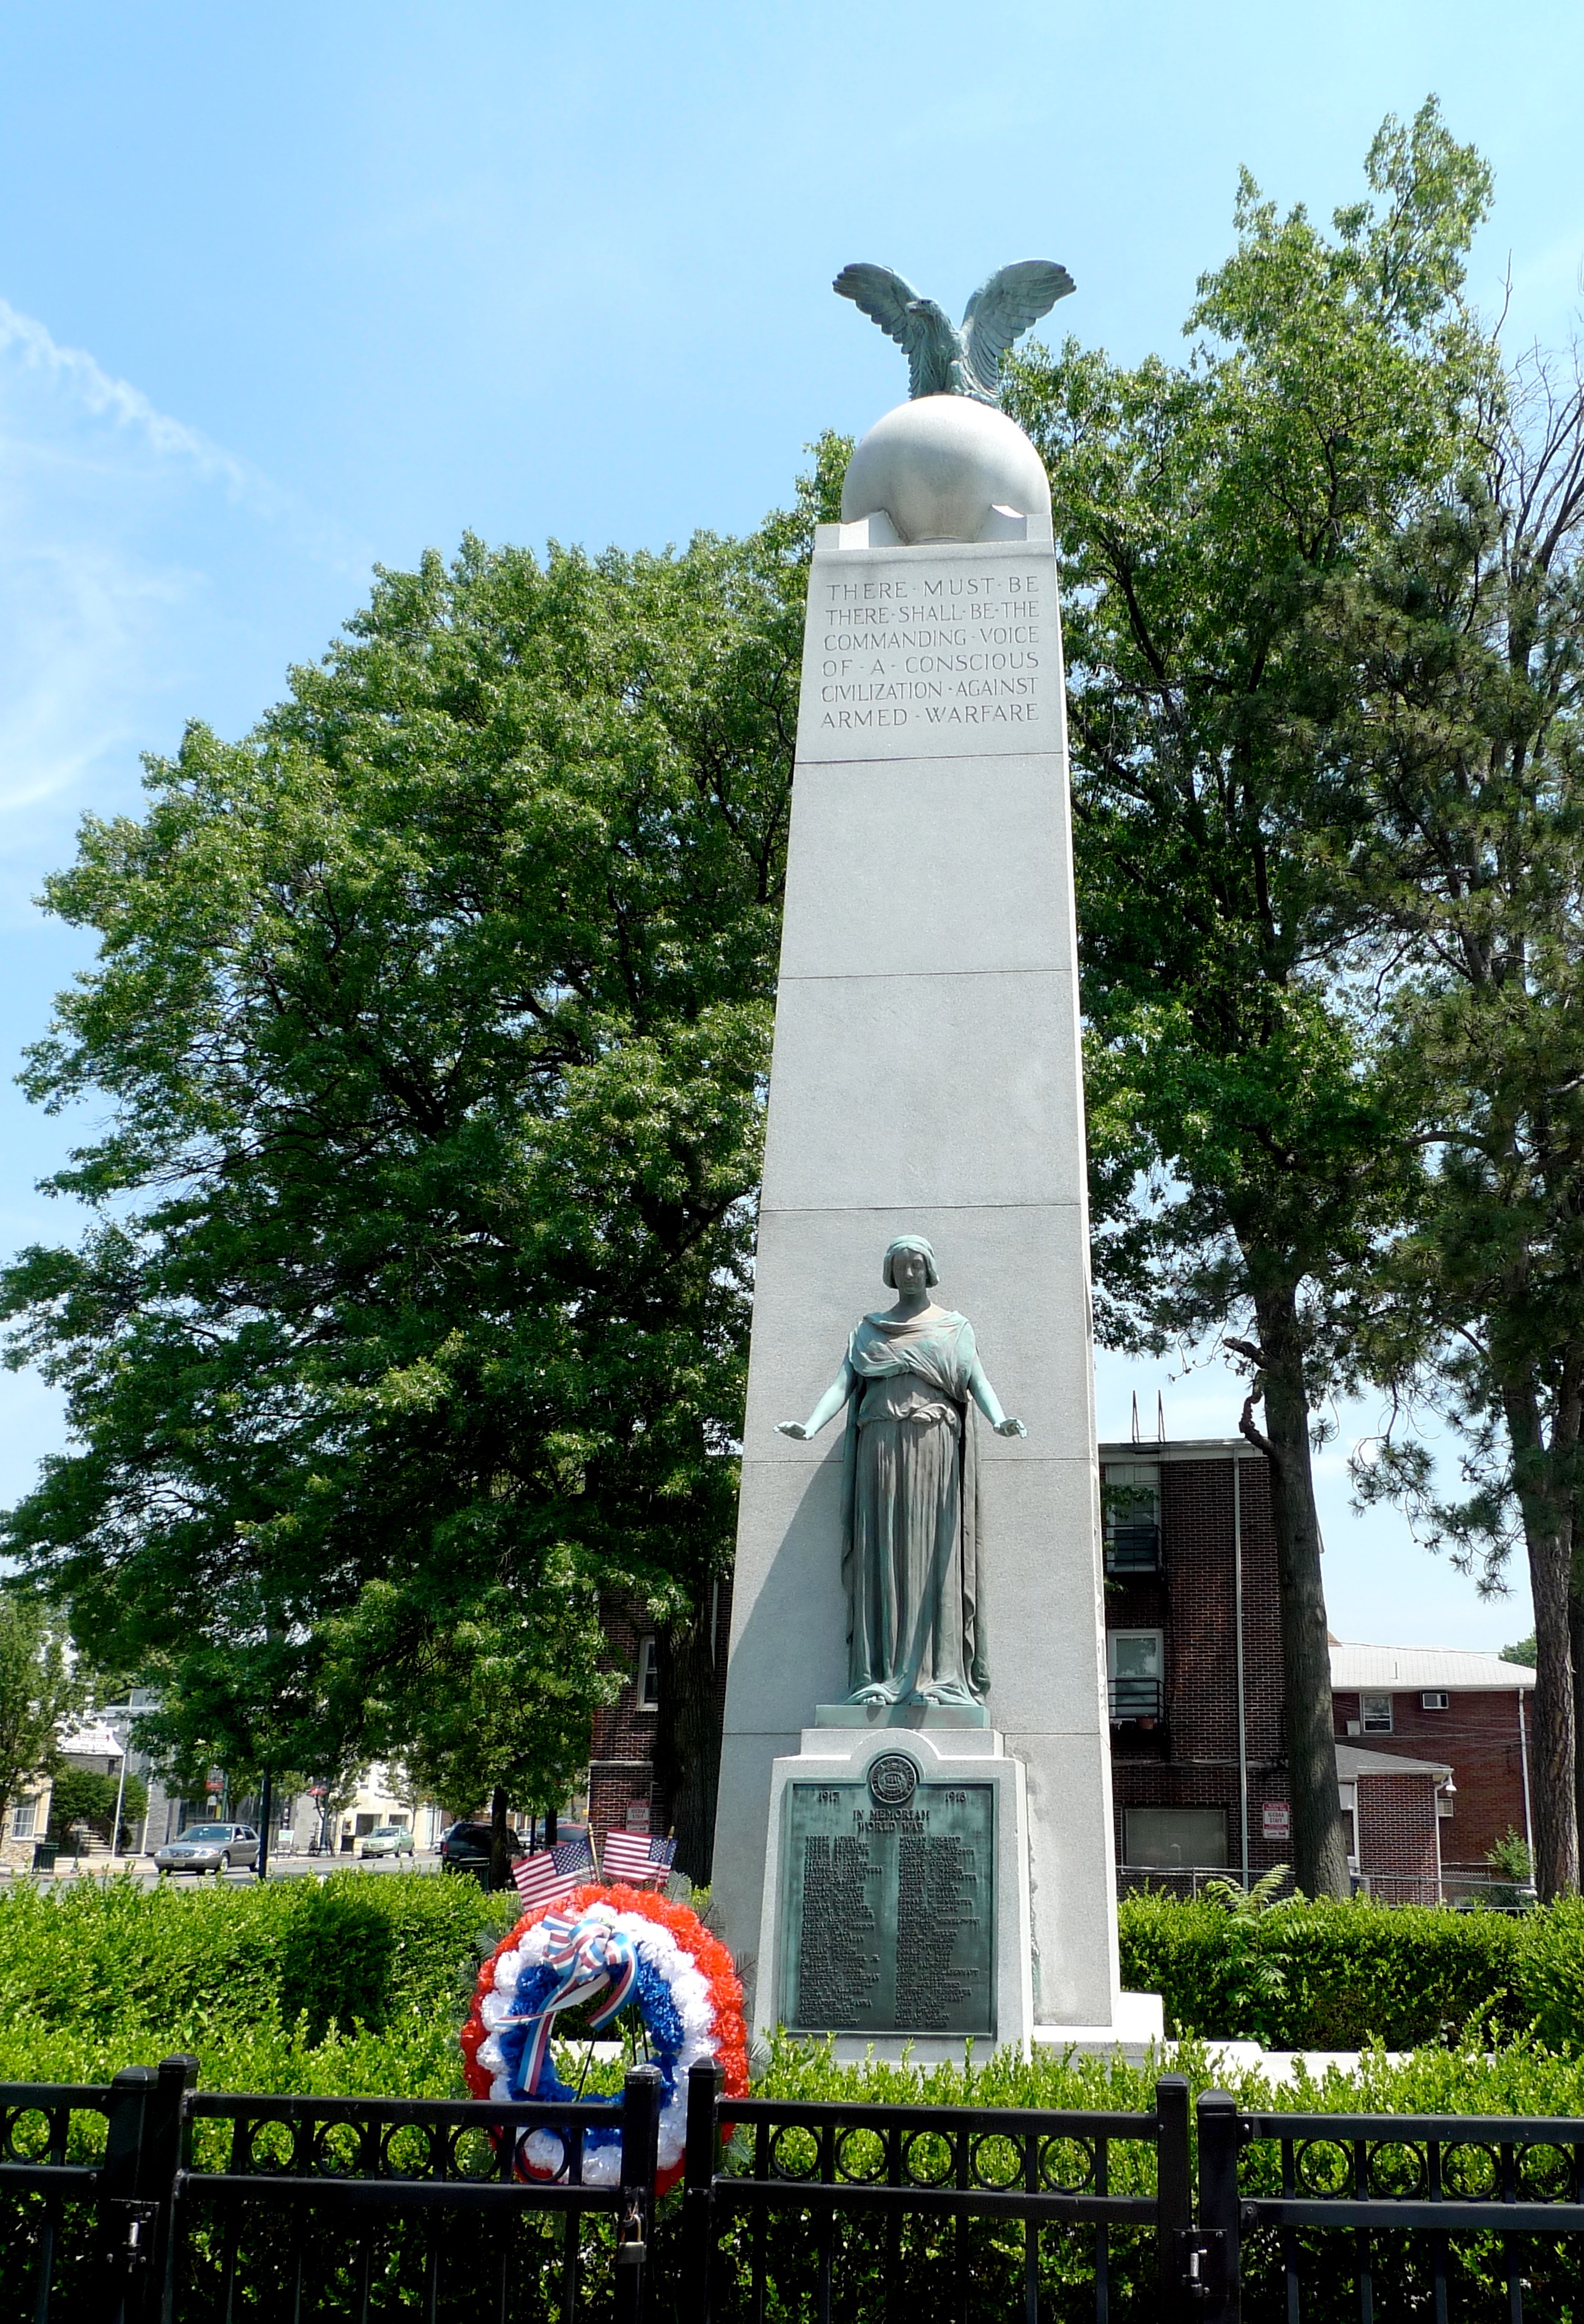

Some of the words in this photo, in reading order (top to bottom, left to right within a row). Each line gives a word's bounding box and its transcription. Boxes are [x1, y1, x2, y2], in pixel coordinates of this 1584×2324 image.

[825, 581, 908, 601] THERE
[923, 577, 995, 597] MUST
[1008, 576, 1039, 594] BE
[825, 607, 890, 626] THERE
[897, 604, 963, 623] SHALL
[970, 602, 995, 620] BE
[1001, 600, 1040, 619] THE
[823, 628, 967, 652] COMMANDING
[979, 625, 1040, 645] VOICE
[822, 659, 853, 677] OF
[869, 658, 885, 675] A
[905, 652, 1039, 674] CONSCIOUS
[821, 681, 943, 702] CIVILIZATION
[956, 677, 1039, 697] AGAINST
[820, 708, 908, 729] ARMED
[925, 702, 1039, 724] WARFARE
[818, 1790, 840, 1803] 1917
[852, 1809, 863, 1822] IN
[870, 1809, 929, 1821] MEMORIAM
[858, 1821, 895, 1833] WORLD
[902, 1821, 925, 1833] WAR
